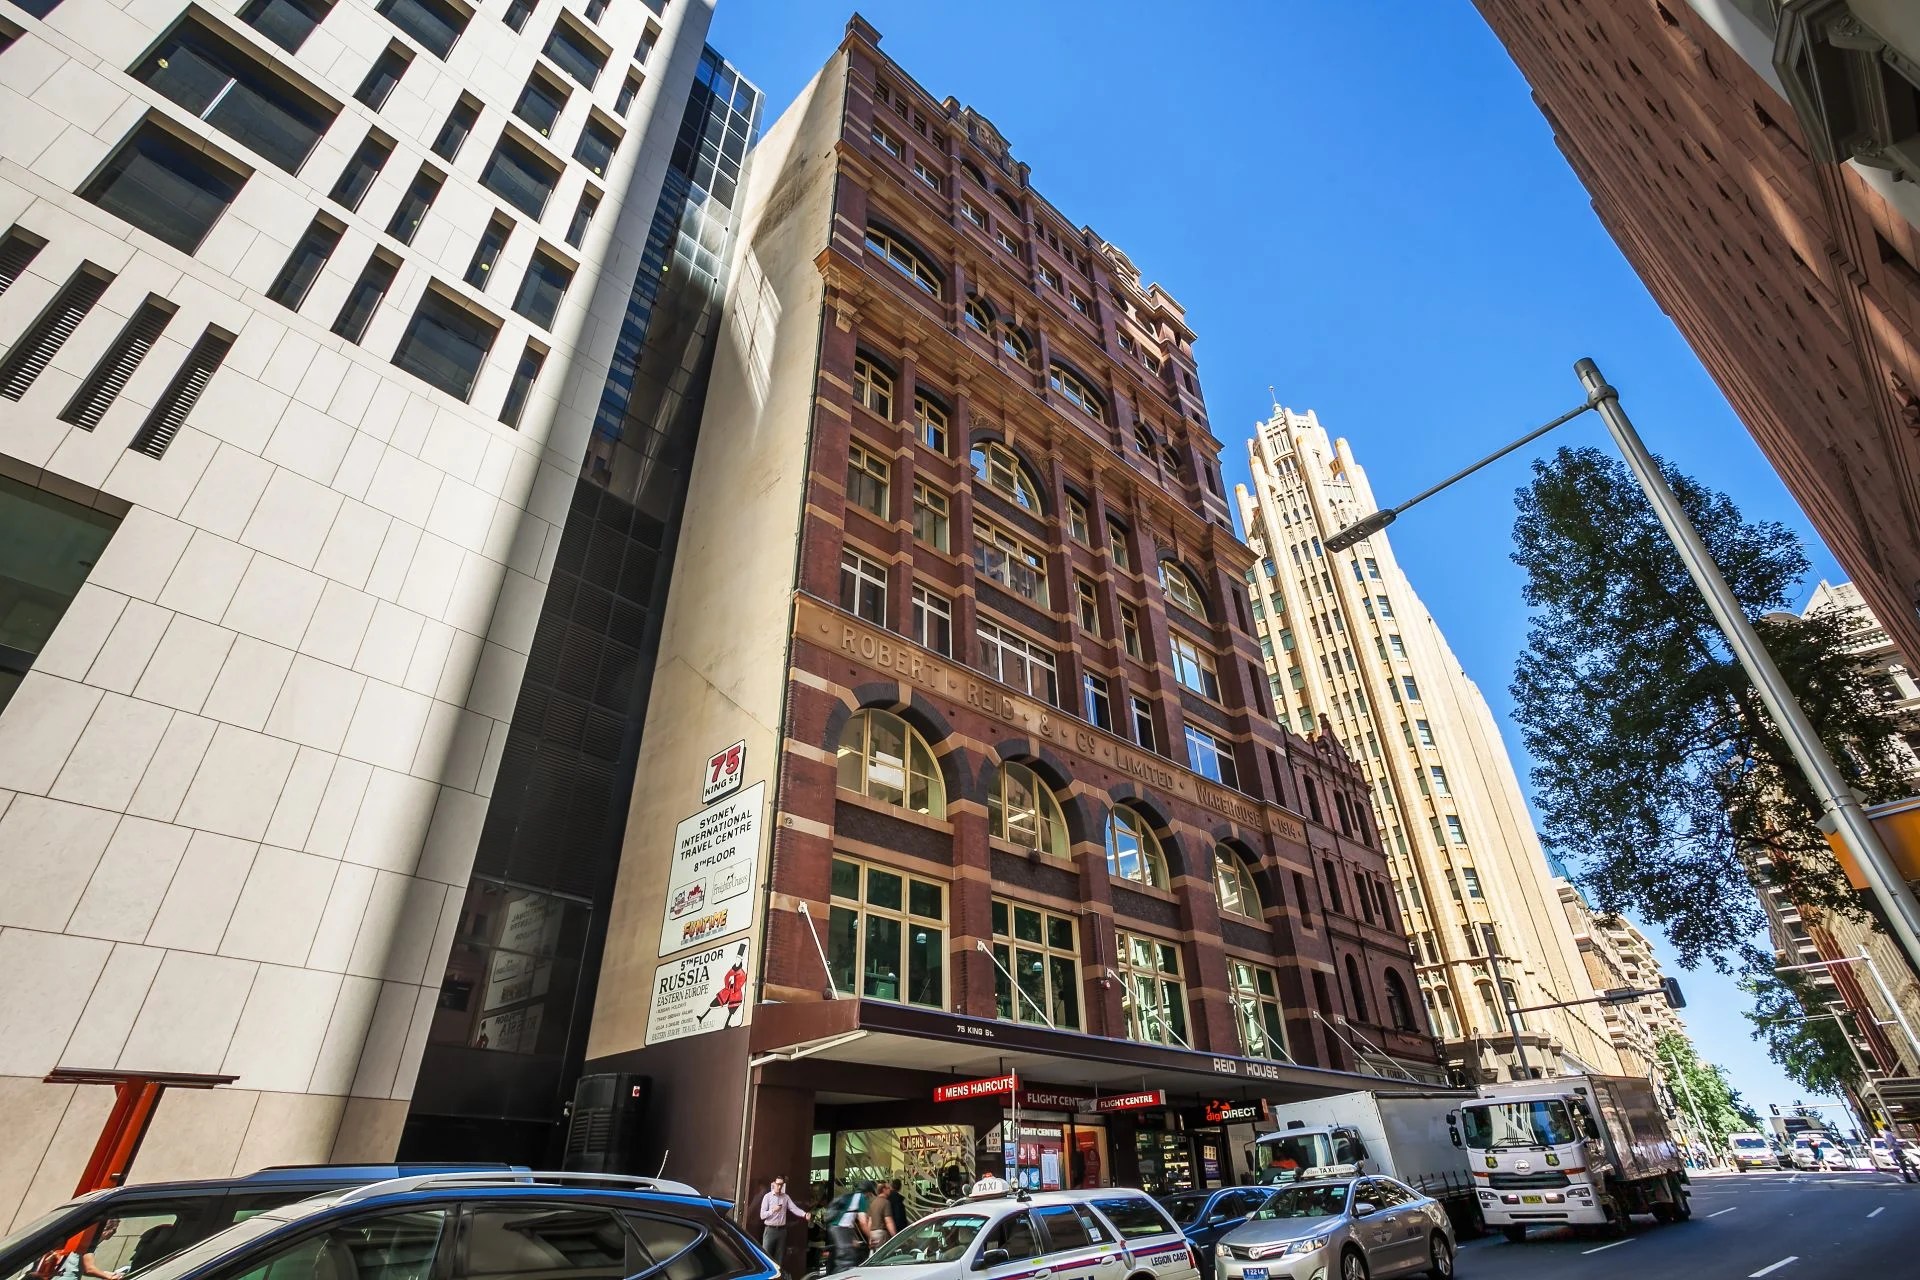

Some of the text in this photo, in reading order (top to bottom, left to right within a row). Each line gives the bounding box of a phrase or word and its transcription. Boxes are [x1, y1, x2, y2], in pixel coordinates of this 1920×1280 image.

[841, 624, 940, 690] ROBERT
[967, 680, 1015, 721] REID
[1040, 712, 1053, 738] &
[1114, 746, 1174, 790] LIMITED
[1195, 782, 1262, 828] WAREHOUSE
[711, 745, 741, 783] 75
[705, 772, 739, 797] KING ST
[699, 804, 737, 829] SYDNEY
[681, 809, 753, 850] INTERNATIONAL
[680, 821, 752, 861] TRAVEL CENTRE
[706, 846, 736, 868] FLOOR
[693, 949, 724, 968] FLOOR
[659, 965, 710, 995] RUSSIA
[657, 984, 709, 1007] EASTERN EUROPE
[956, 1025, 966, 1033] 75
[967, 1026, 983, 1035] KING
[1213, 1058, 1279, 1079] REID HOUSE
[945, 1077, 1015, 1098] MENS HAIRCUTS
[1027, 1093, 1083, 1107] FLIGHT CENT
[1100, 1095, 1153, 1108] FLIGHT CENTRE
[1206, 1106, 1256, 1121] digiDIRECT
[1037, 1128, 1061, 1137] CENTRE
[978, 1181, 997, 1192] TAXI
[1151, 1252, 1188, 1266] LEGION CABS
